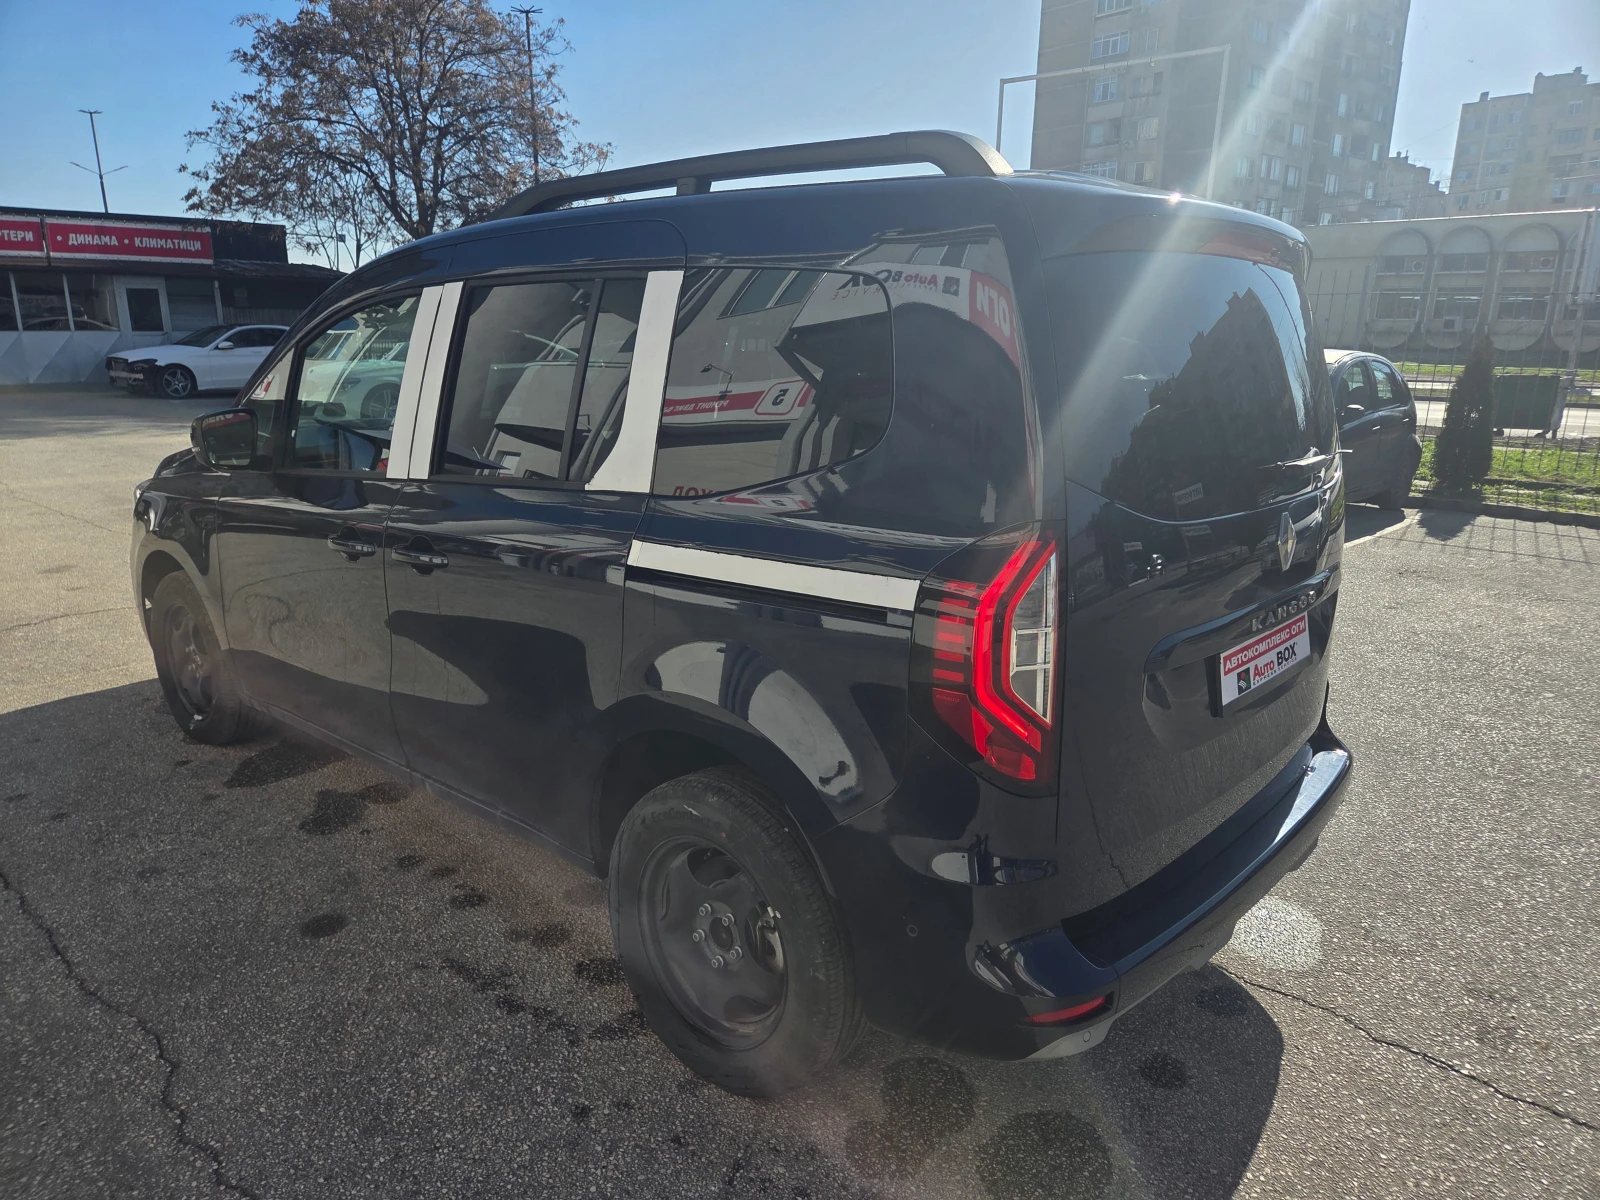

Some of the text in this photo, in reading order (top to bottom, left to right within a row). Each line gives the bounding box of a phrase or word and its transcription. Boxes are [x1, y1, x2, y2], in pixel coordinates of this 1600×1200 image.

[0, 229, 34, 242] ТЕРИ
[68, 233, 202, 252] ДИНАМА КЛИМАТИЦИ
[1252, 590, 1317, 631] KANGOO
[1224, 619, 1305, 672] АВТОКОМПЛЕКС ОГИ
[1276, 641, 1297, 667] BOX
